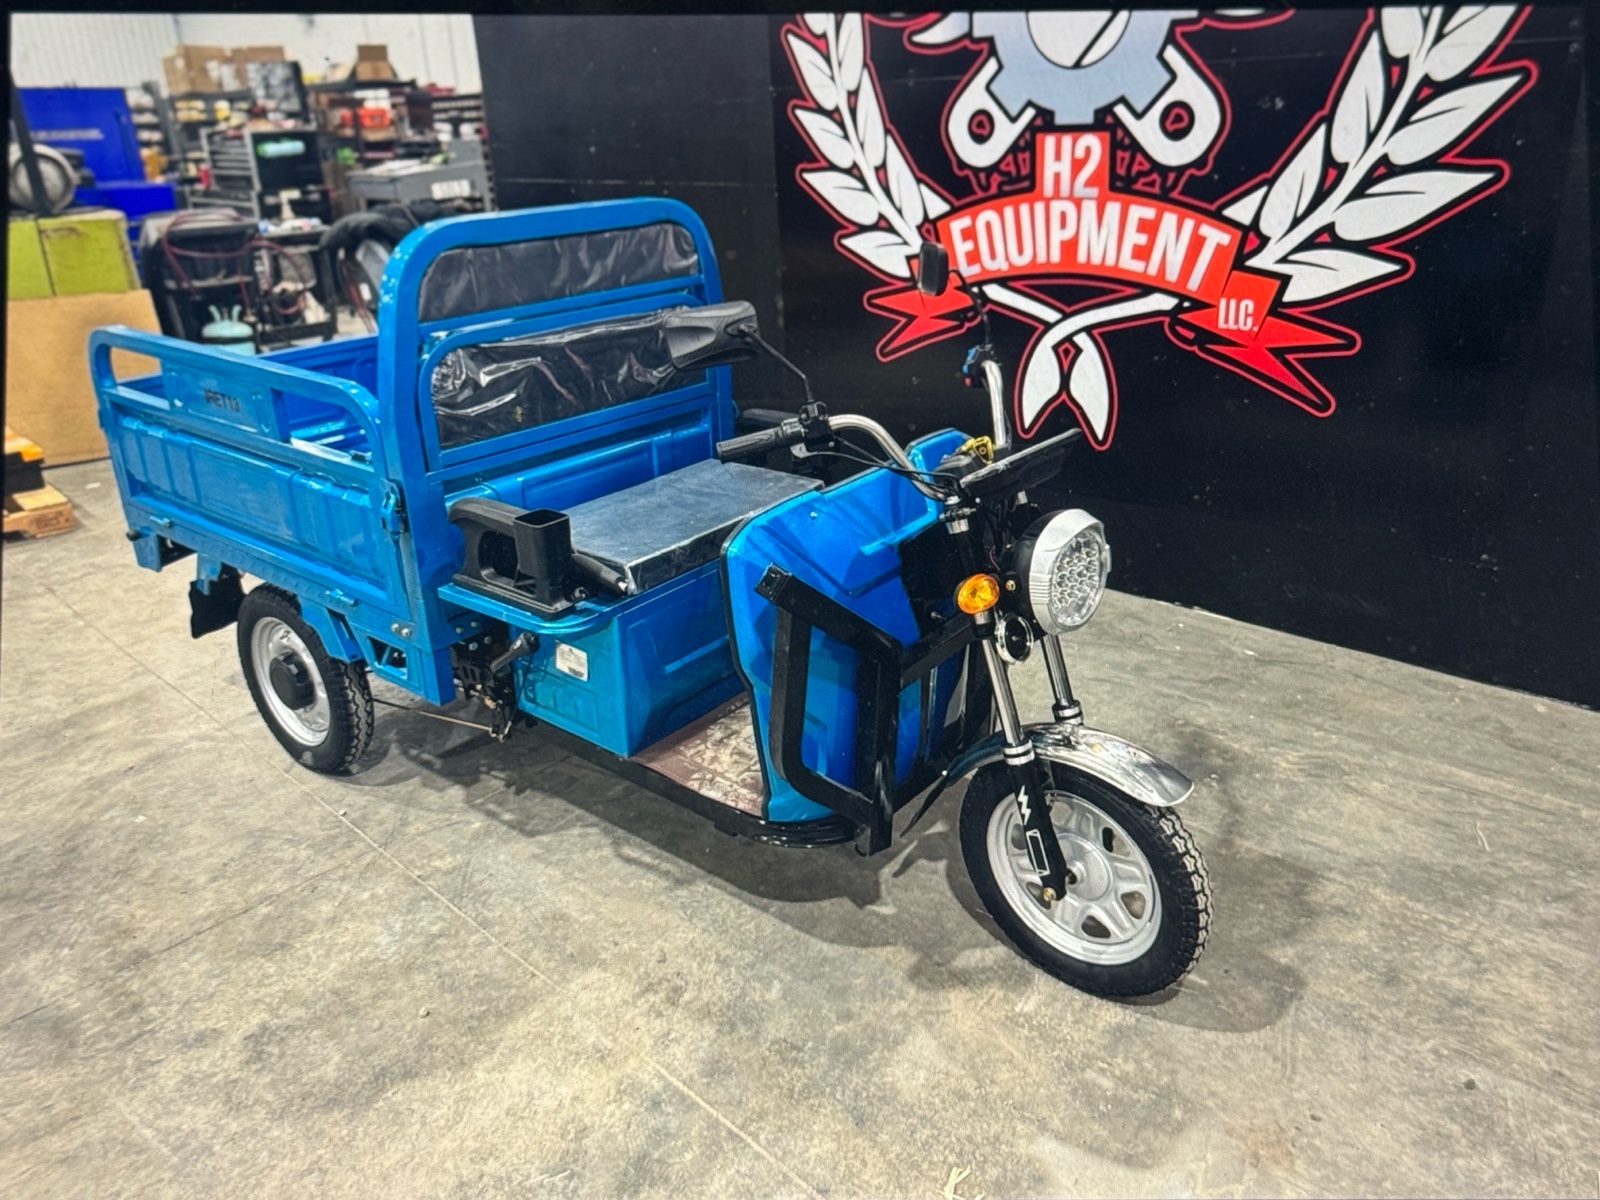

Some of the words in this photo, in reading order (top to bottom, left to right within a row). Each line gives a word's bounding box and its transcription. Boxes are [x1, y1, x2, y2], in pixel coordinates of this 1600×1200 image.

[1043, 134, 1101, 198] H2
[949, 198, 1231, 292] EQUIPMENT
[1218, 298, 1258, 331] LLC.
